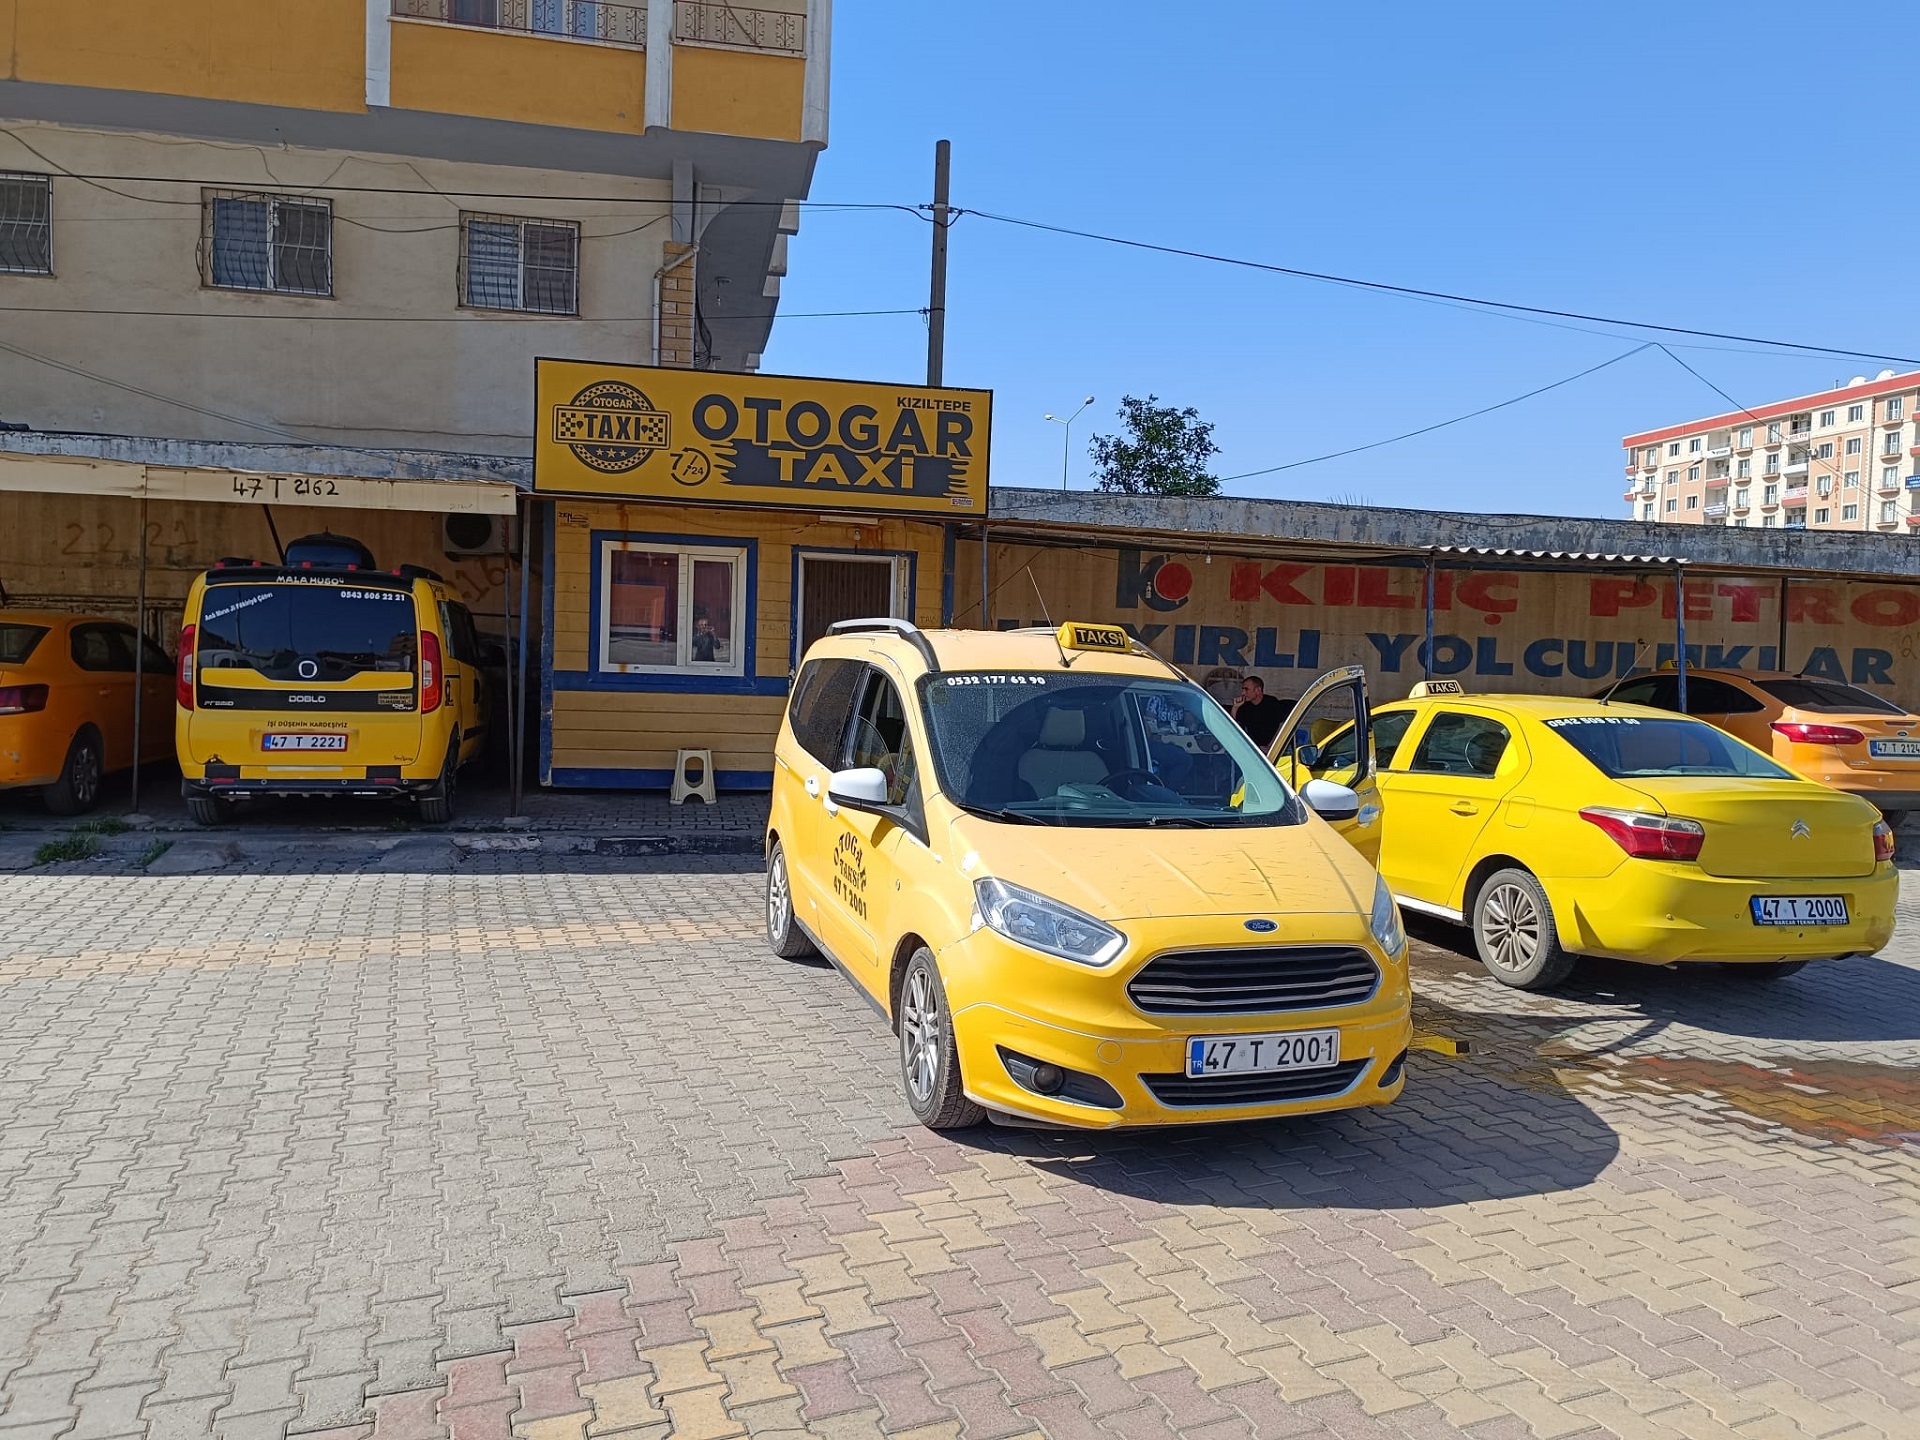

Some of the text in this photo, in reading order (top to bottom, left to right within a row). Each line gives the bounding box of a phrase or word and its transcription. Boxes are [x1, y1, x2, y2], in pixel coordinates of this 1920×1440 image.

[592, 397, 633, 409] OTOGAR
[897, 396, 971, 412] KIZILTEPE
[583, 414, 641, 441] TAXI
[692, 394, 973, 458] OTOGAR
[233, 475, 339, 499] 47 T 2162
[340, 591, 362, 599] 0543
[382, 593, 393, 601] 22
[1230, 562, 1519, 625] KILIÇ
[947, 675, 1046, 686] 0532 177 62 90
[288, 695, 326, 703] DOBLO
[271, 736, 287, 748] 47
[295, 736, 303, 748] T
[311, 736, 343, 748] 2221
[1877, 742, 1920, 753] 47 T 2124
[848, 890, 867, 920] 2001
[1763, 899, 1843, 918] 47 T 2000
[1205, 1035, 1333, 1069] 47 T 2001
[1192, 1060, 1203, 1069] TR
